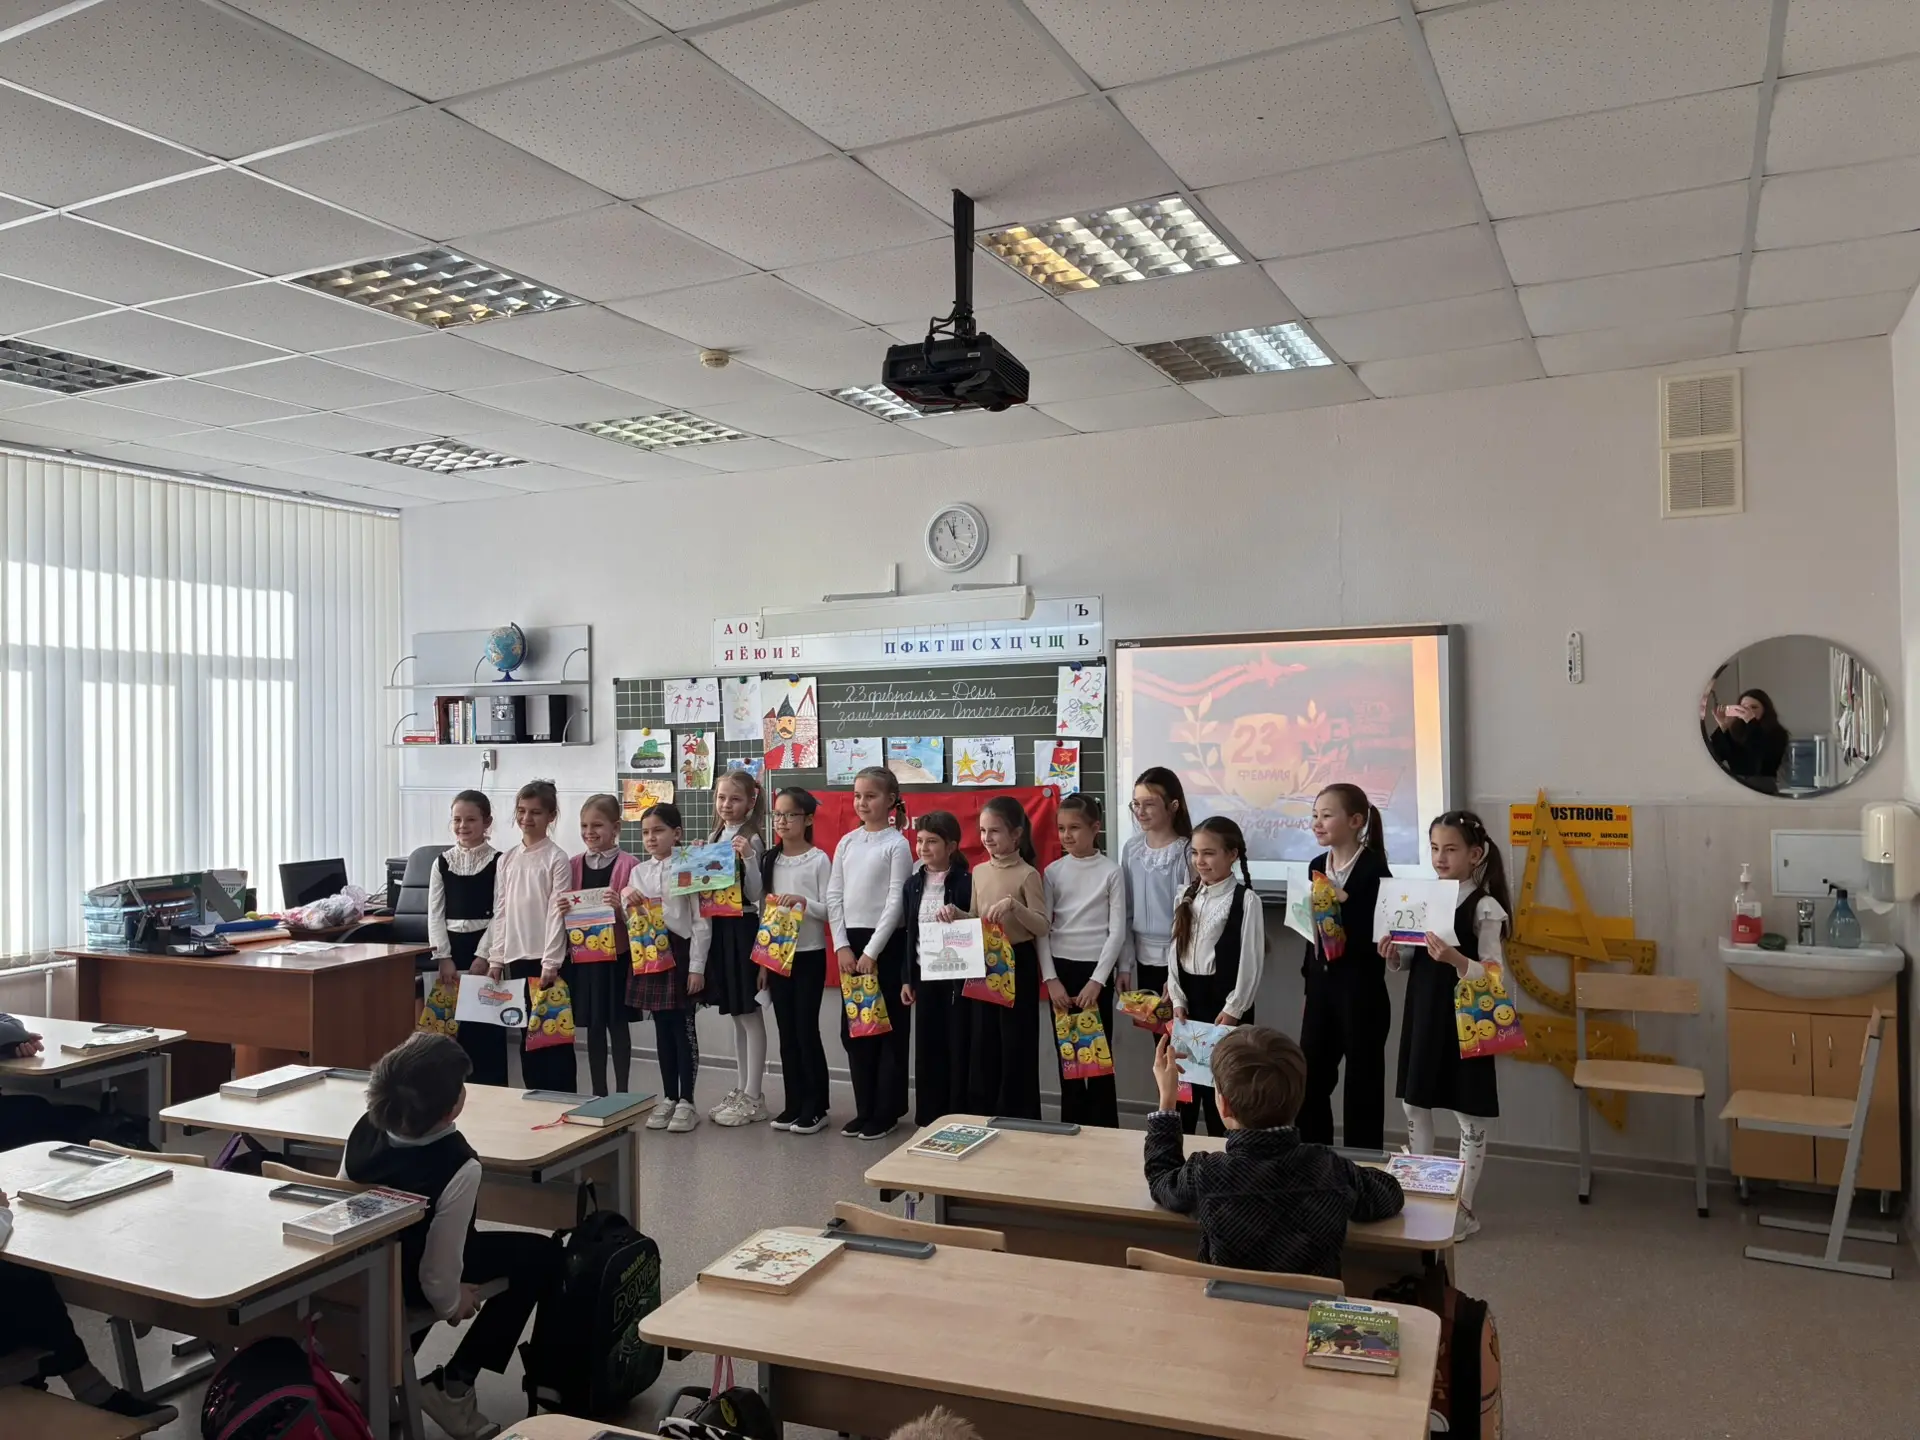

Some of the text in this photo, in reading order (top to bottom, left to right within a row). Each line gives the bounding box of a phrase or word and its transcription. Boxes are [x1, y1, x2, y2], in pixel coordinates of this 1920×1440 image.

[1075, 604, 1089, 616] Ъ
[1080, 672, 1103, 693] 23
[868, 683, 938, 712] февраля
[952, 681, 997, 700] День
[837, 706, 945, 733] защитника
[831, 740, 845, 751] 23
[1230, 721, 1280, 765] 23
[1238, 768, 1291, 782] ФЕВРАЛЯ
[1550, 806, 1613, 822] USTRONG
[1393, 910, 1417, 930] 23
[1497, 1026, 1517, 1042] Smile
[620, 1250, 647, 1283] monster
